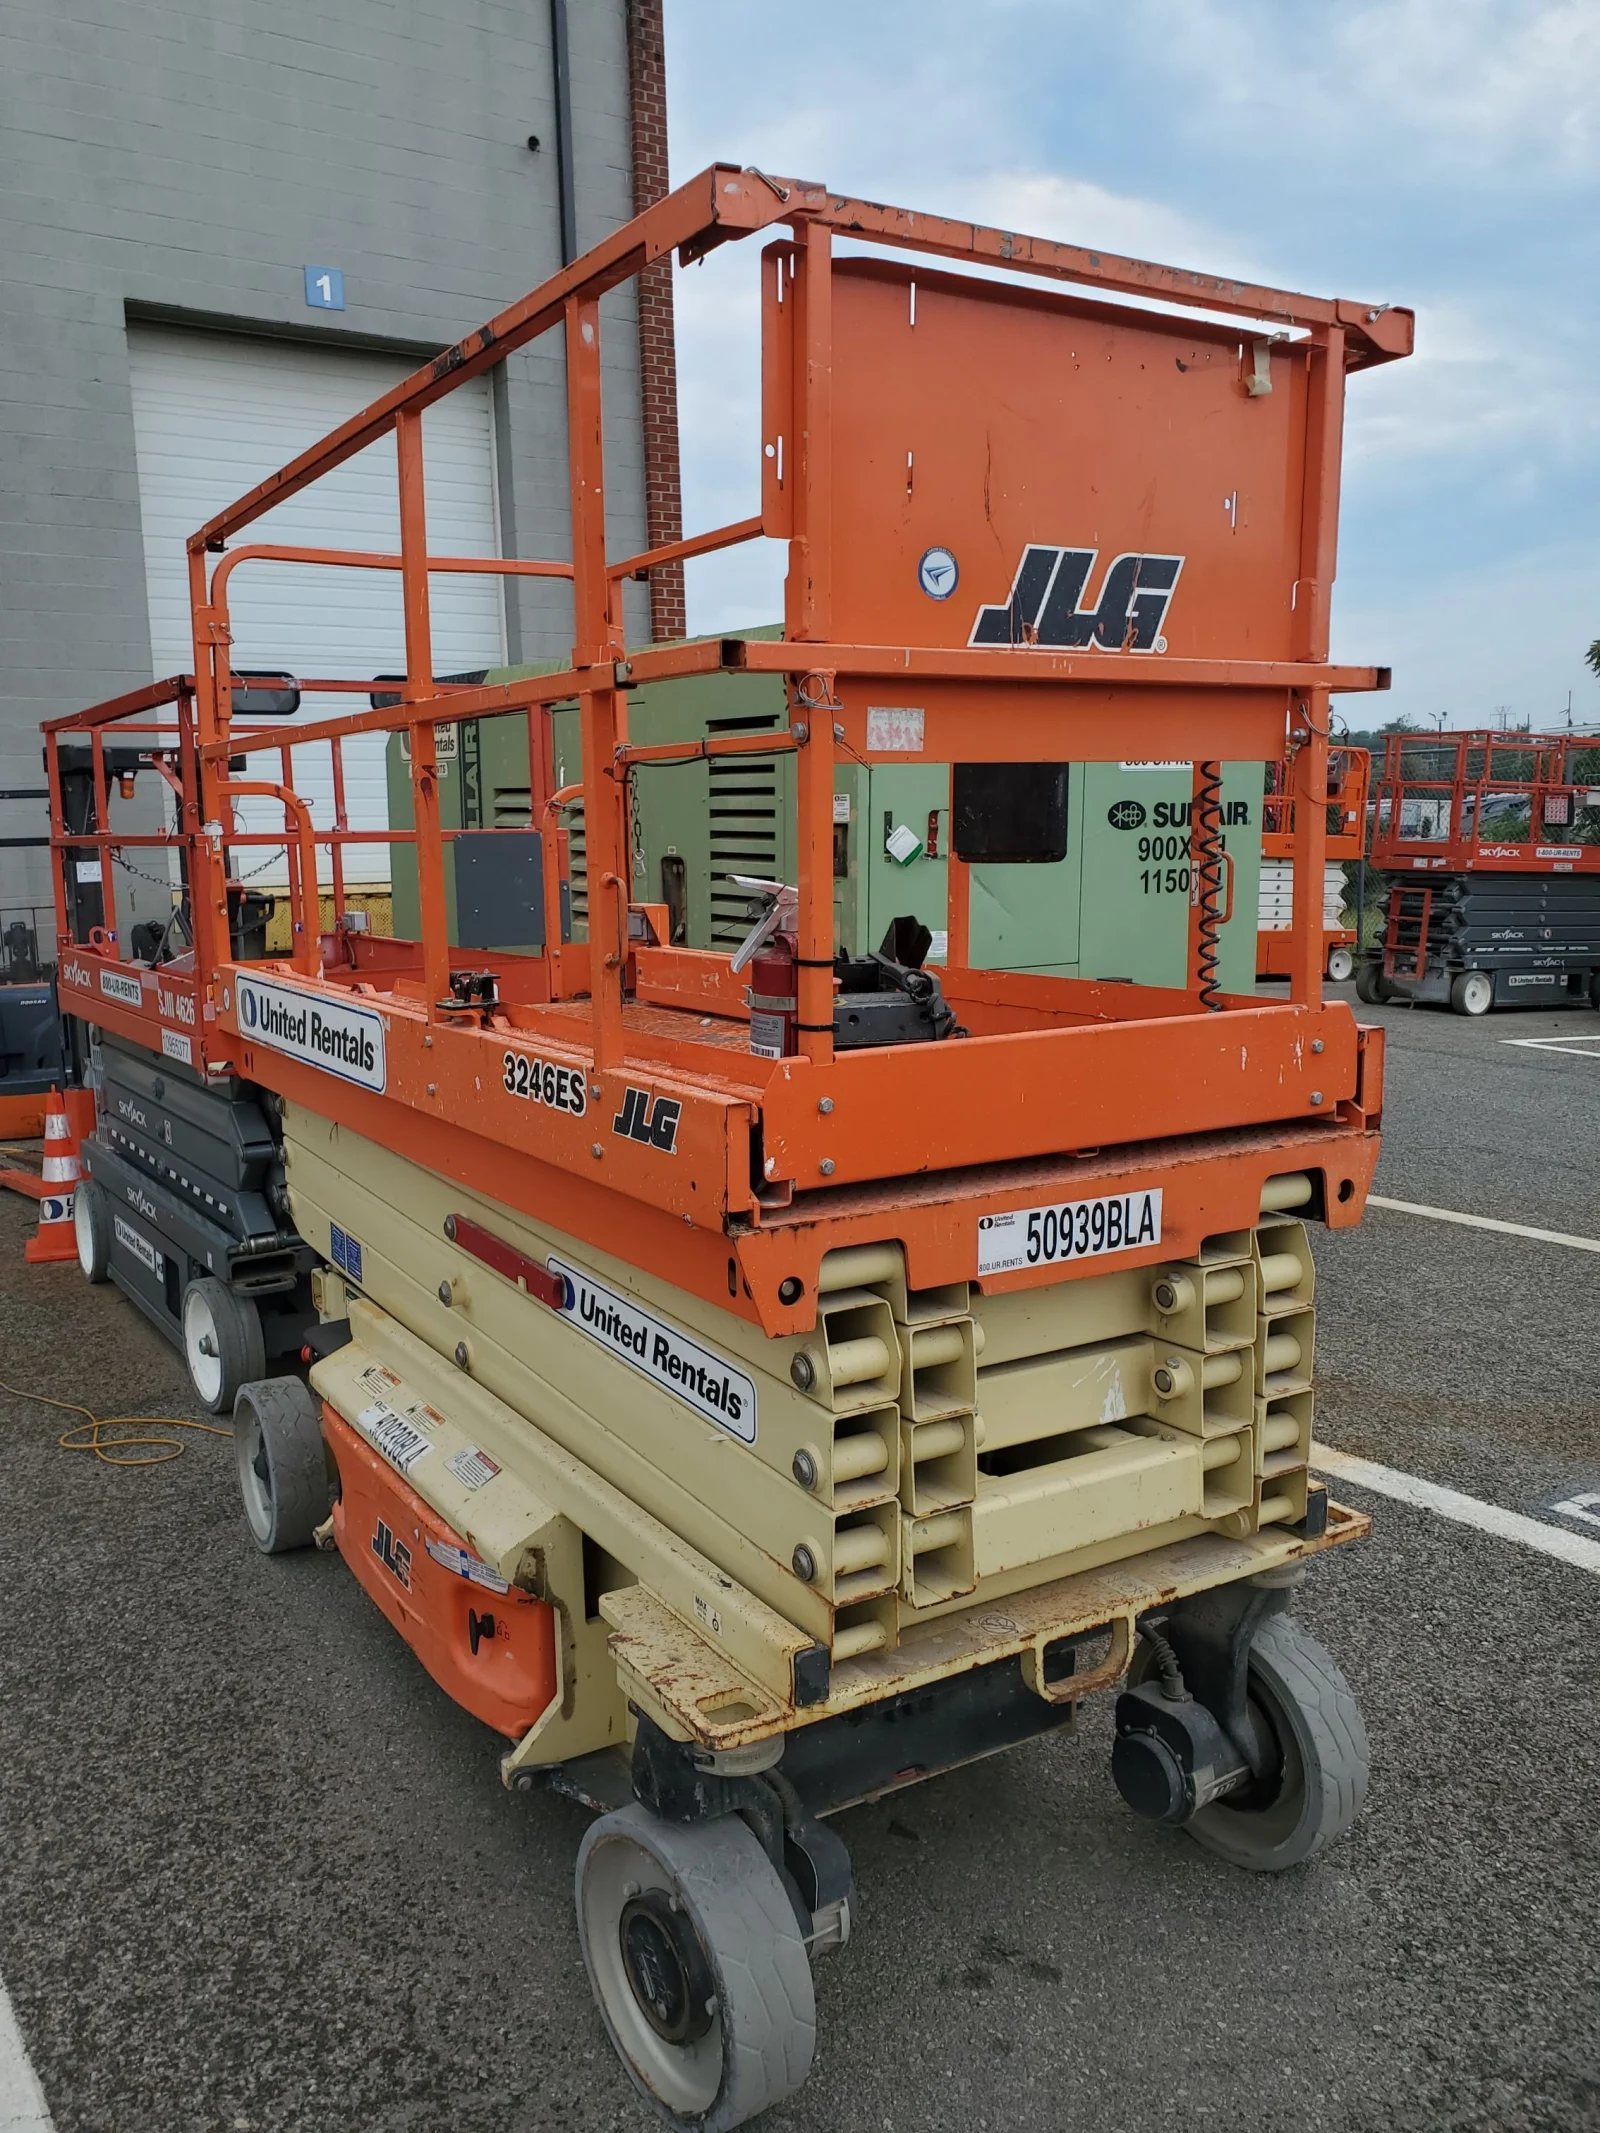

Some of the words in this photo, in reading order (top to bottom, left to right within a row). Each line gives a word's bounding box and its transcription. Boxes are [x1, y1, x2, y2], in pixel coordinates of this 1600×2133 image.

[316, 275, 331, 301] 1
[967, 543, 1186, 653] JLG
[1479, 846, 1520, 858] SKYJACK
[1491, 929, 1524, 940] SKYJACK
[63, 960, 92, 988] SKYJACK
[102, 975, 139, 1001] 800-UR-RENTS
[175, 995, 195, 1026] 4626
[260, 996, 307, 1046] United
[311, 1011, 374, 1071] Rentals
[504, 1053, 586, 1115] 3246ES
[118, 1099, 148, 1128] SKYJACK
[612, 1087, 682, 1153] JLG
[126, 1187, 158, 1222] SKYJACK
[1026, 1194, 1155, 1263] 50939BLA
[580, 1288, 648, 1358] United
[652, 1333, 742, 1420] Rentals
[371, 1516, 413, 1594] JLG
